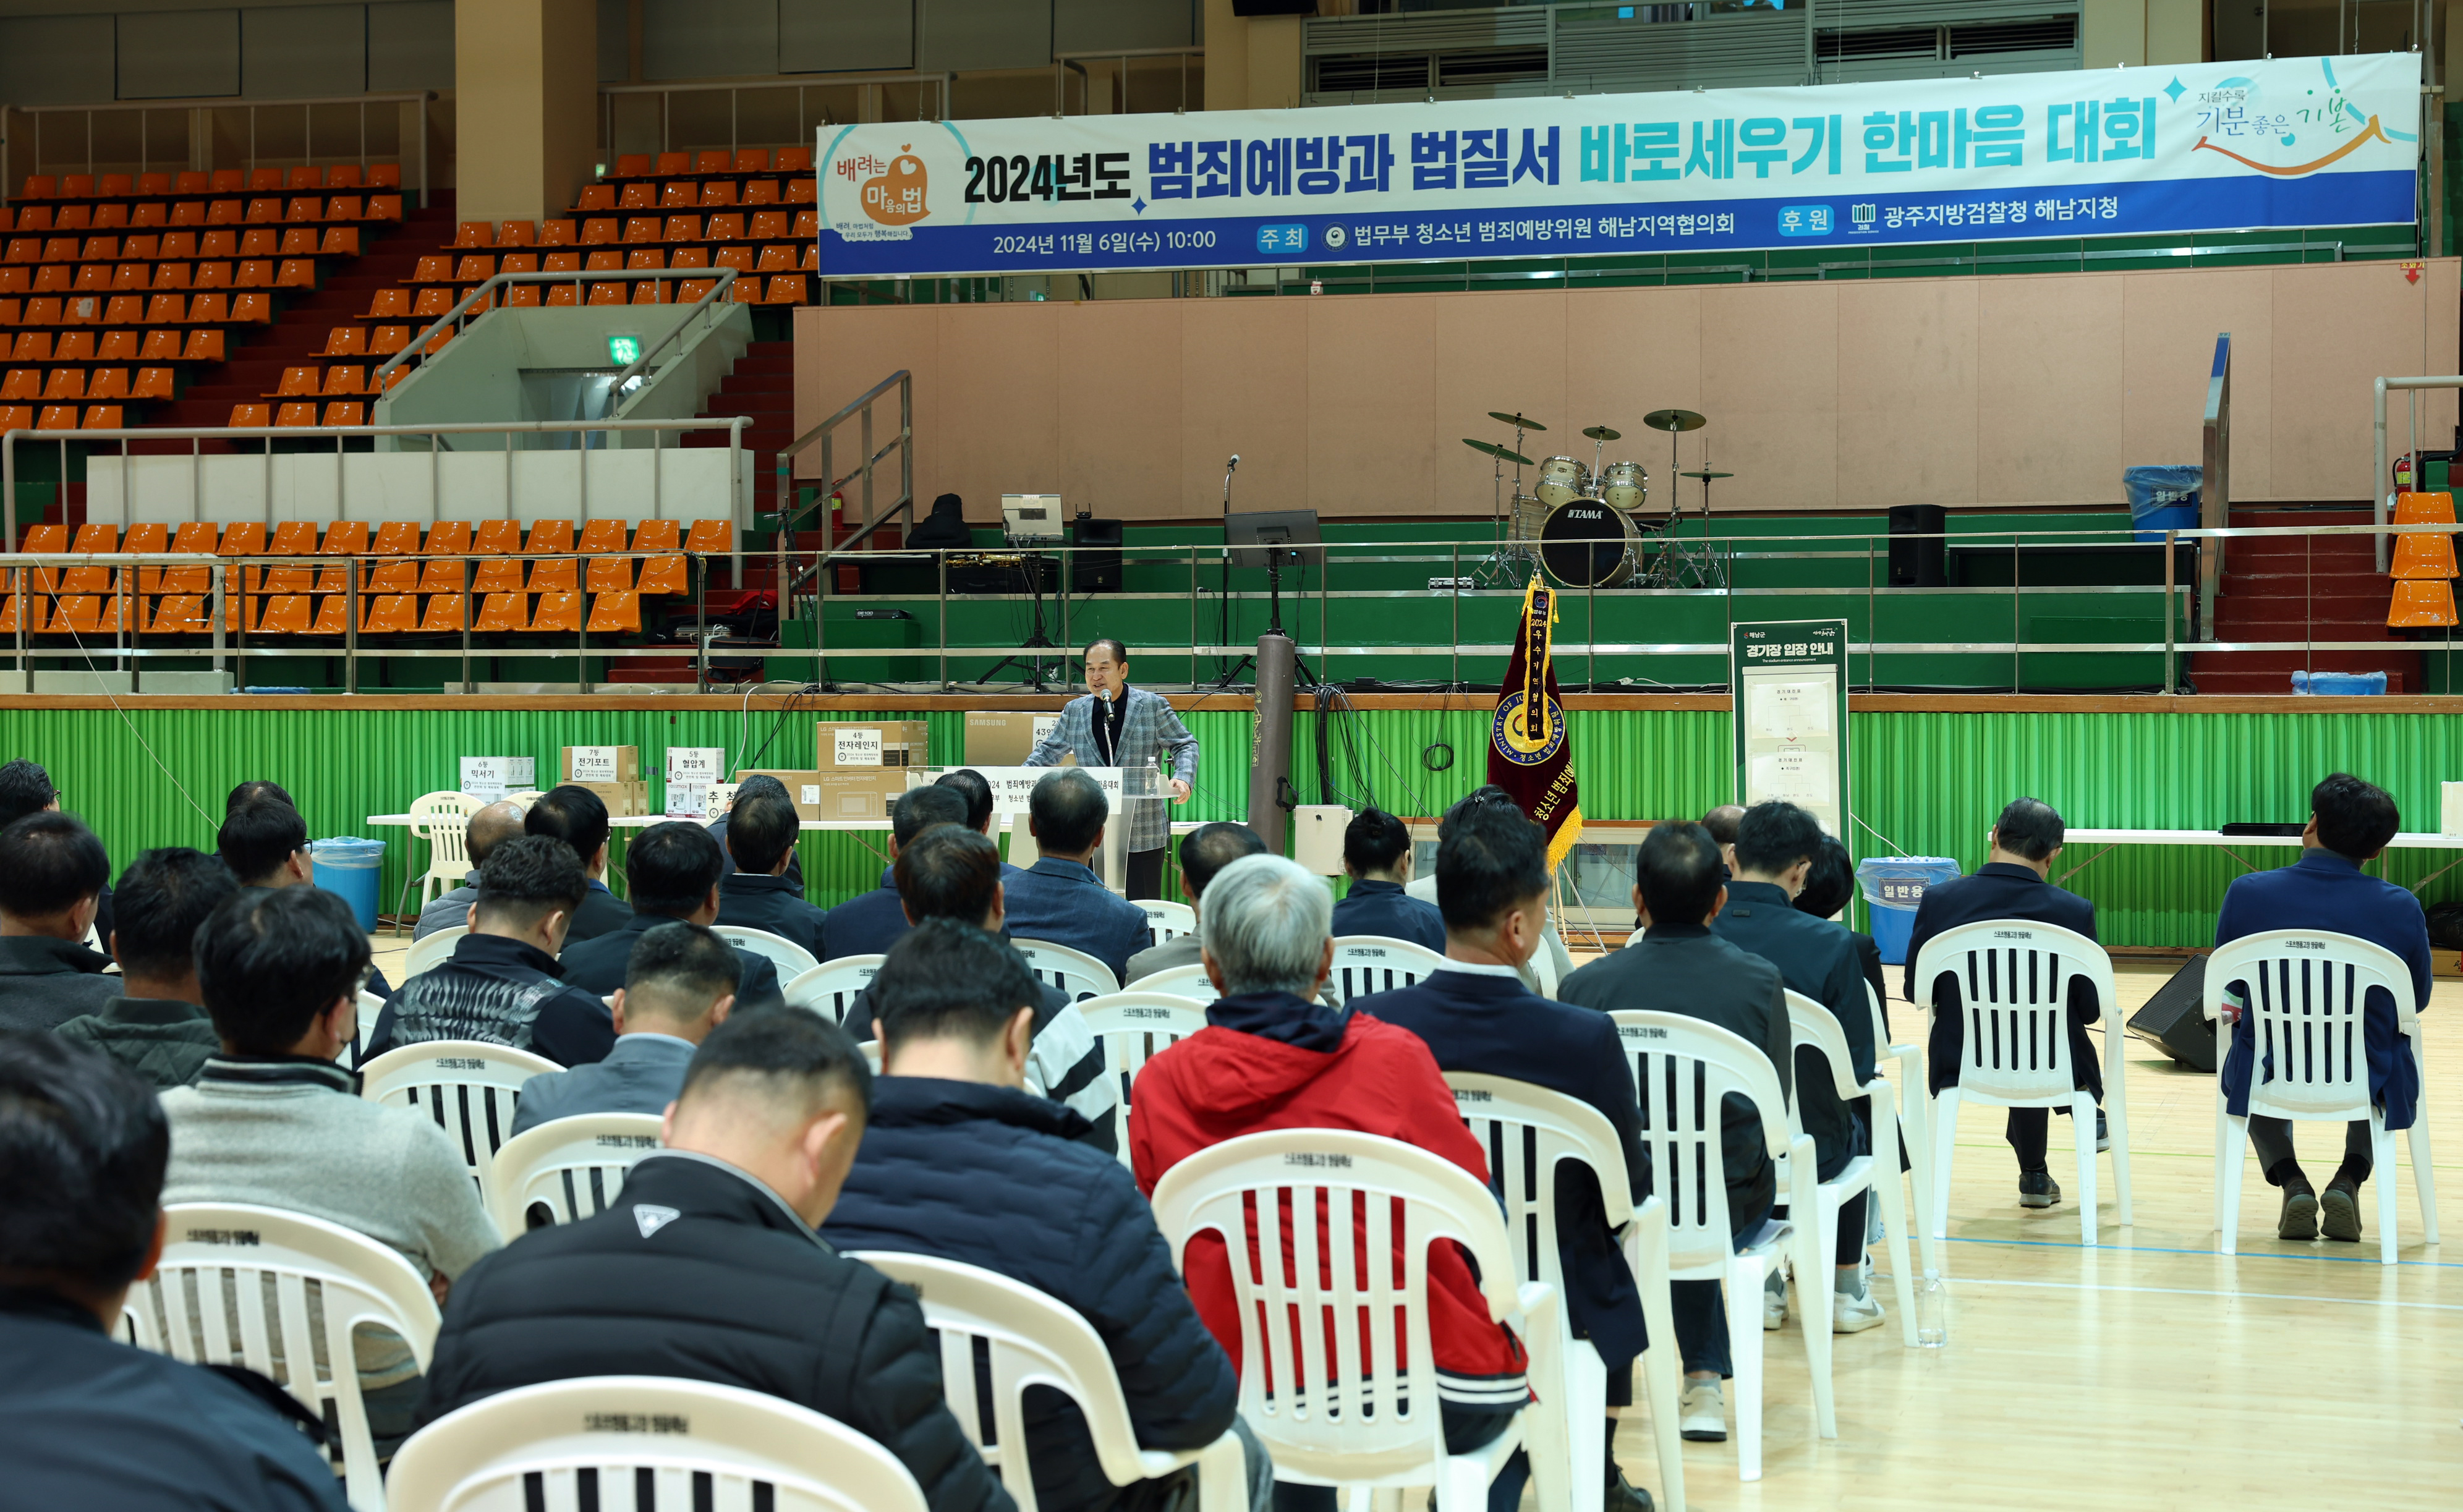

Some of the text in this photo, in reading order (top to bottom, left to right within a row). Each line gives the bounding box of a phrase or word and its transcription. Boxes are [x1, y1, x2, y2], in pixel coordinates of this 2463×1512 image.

[2198, 90, 2245, 103] 지킬수록
[2197, 106, 2250, 136] 기분
[2252, 114, 2290, 135] 좋은
[964, 97, 2156, 203] 2024년도 범죄예방과 법질서 바로세우기 한마음 대회
[837, 155, 887, 182] 배려는
[1884, 196, 2119, 227] 광주지방검찰청 해남지청
[1355, 224, 1410, 246] 법무부
[1415, 222, 1471, 245] 청소년
[1479, 218, 1591, 242] 범죄예방위원
[1598, 213, 1735, 238] 해남지역협의회
[993, 230, 1217, 254] 2024년 11월 6일(수) 10:00
[1574, 509, 1602, 519] TAMA
[1531, 619, 1547, 627] 2024
[1746, 642, 1834, 657] 경기장 입장 안내
[1496, 701, 1513, 755] MINISTRY OF
[838, 741, 878, 750] 전자레인지
[579, 758, 610, 766] 전기포트
[683, 759, 705, 768] 혈압계
[1520, 752, 1541, 762] 청소년
[471, 770, 494, 778] 믹서기
[1534, 790, 1560, 820] 청소년
[1884, 885, 1923, 898] 일반용
[1994, 931, 2017, 939] 스포츠명품고장
[2286, 941, 2310, 949] 스포츠명품고장
